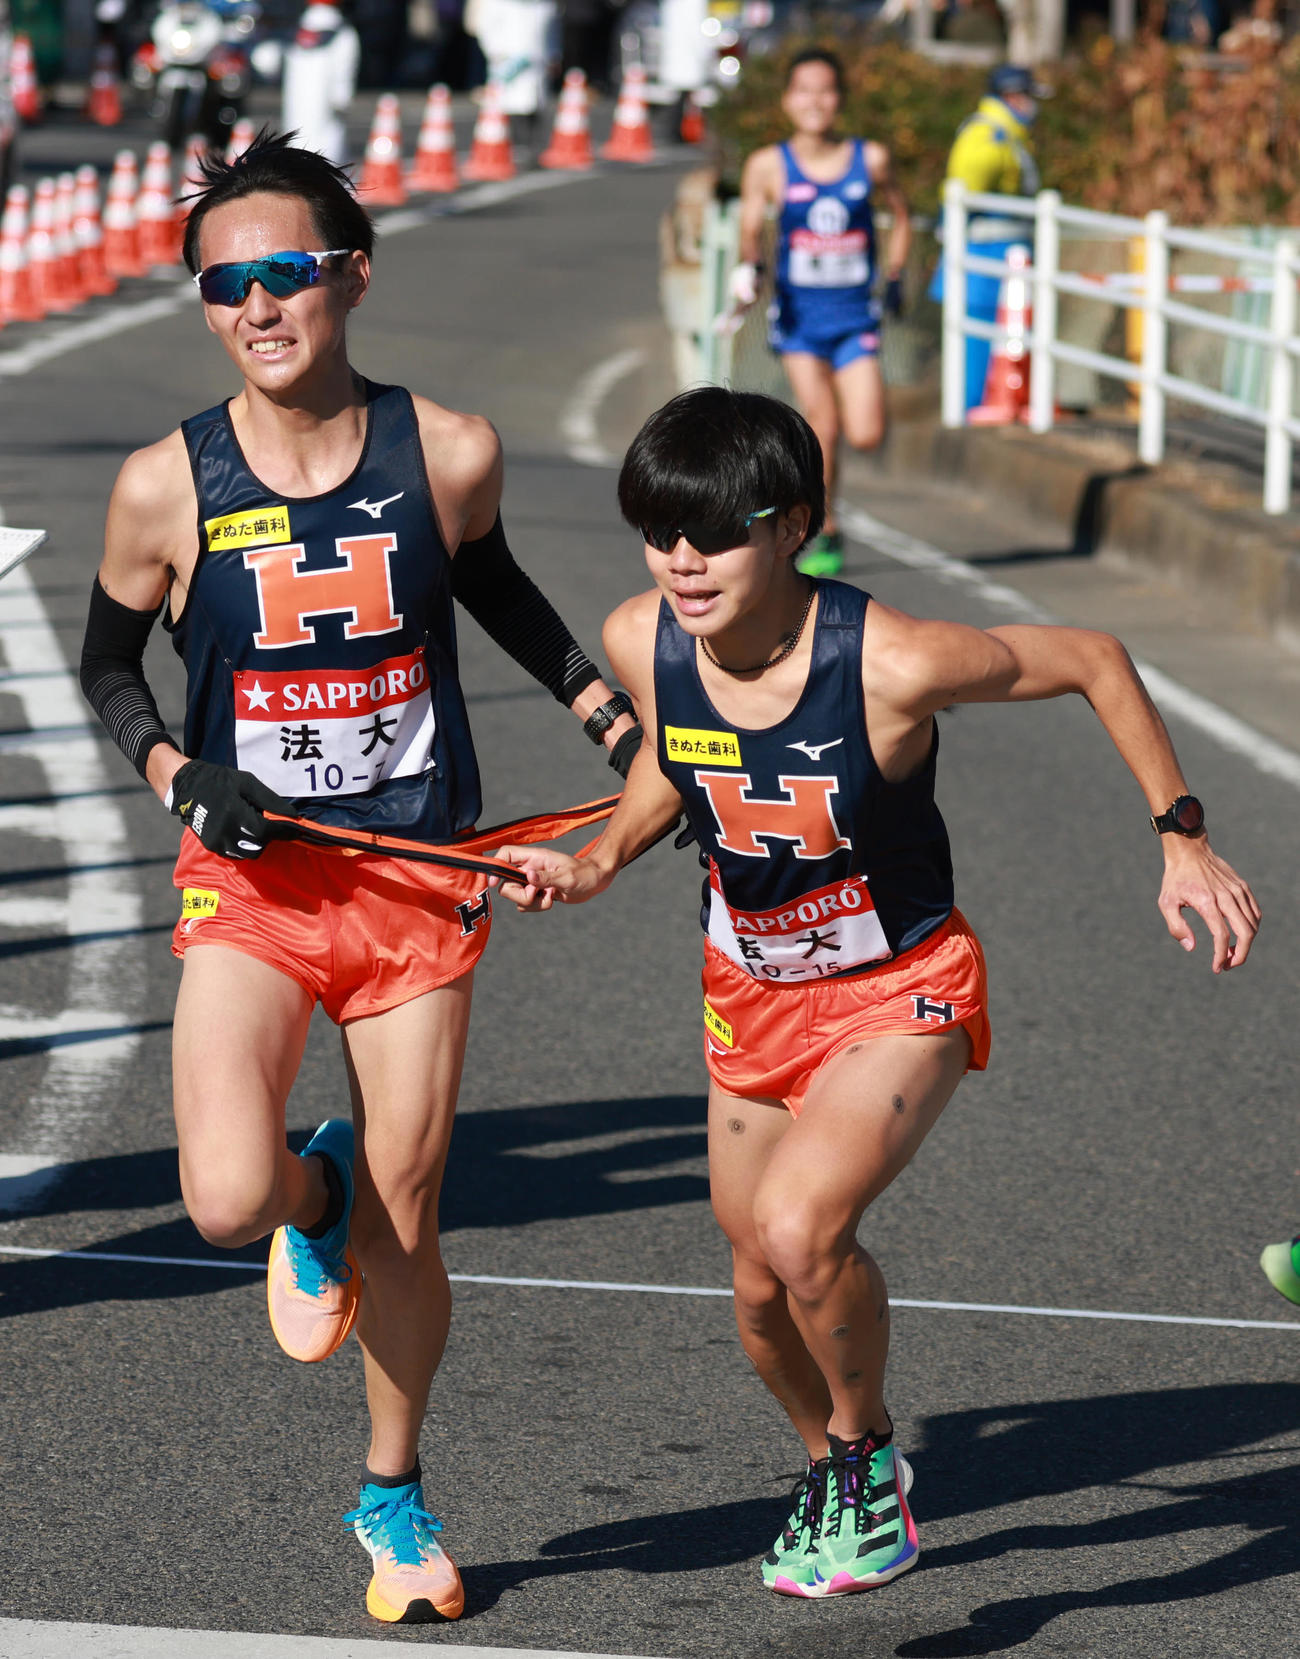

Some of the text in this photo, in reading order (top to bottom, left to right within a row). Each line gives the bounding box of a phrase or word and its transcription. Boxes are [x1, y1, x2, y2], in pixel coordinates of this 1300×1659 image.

[211, 517, 286, 540] きぬた歯科
[243, 532, 403, 649] H
[282, 661, 424, 711] SAPPORO
[669, 738, 737, 757] きぬた歯科
[694, 770, 852, 859] H
[732, 887, 861, 932] APPORO
[910, 994, 955, 1024] H
